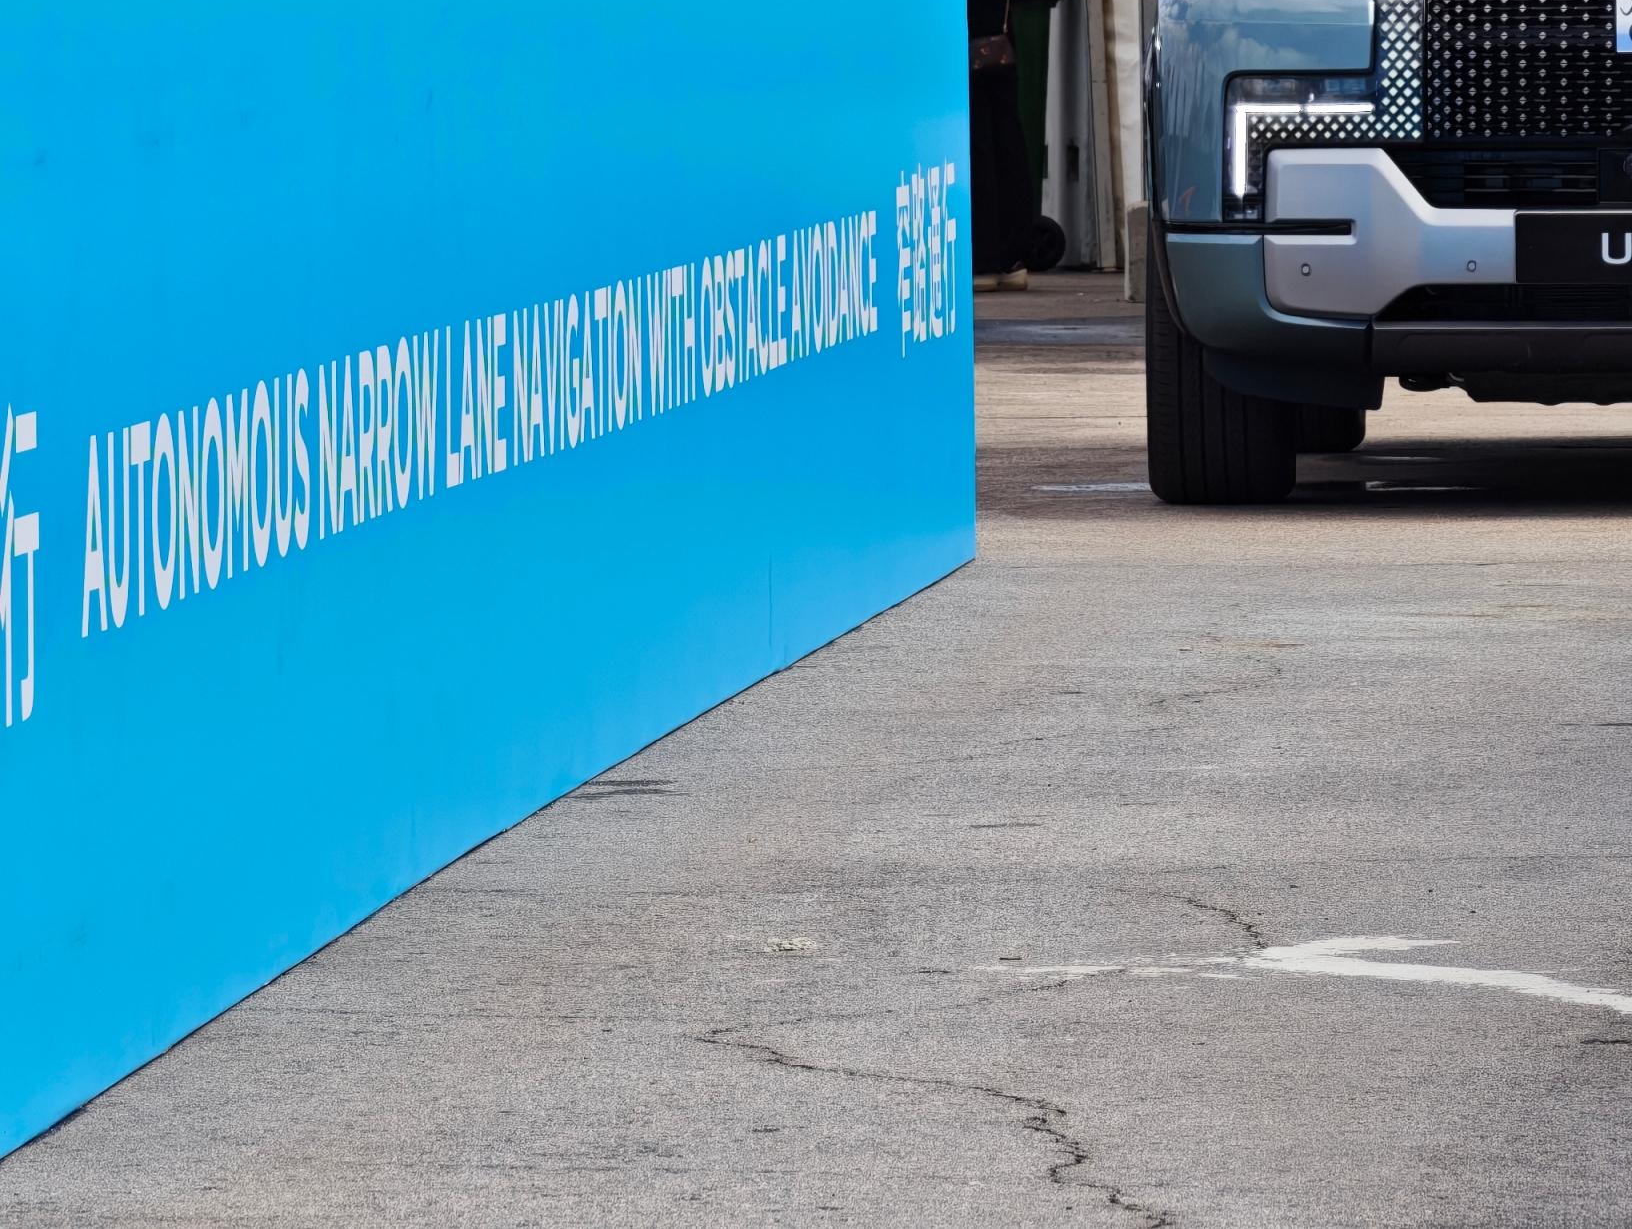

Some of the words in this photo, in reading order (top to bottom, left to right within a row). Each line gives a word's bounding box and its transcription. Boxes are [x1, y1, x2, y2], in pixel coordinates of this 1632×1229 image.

[82, 368, 311, 638] AUTONOMOUS
[319, 329, 439, 540] NARROW
[447, 304, 507, 488] LANE
[514, 277, 642, 466] NAVIGATION
[647, 263, 696, 416] WITH
[700, 234, 787, 397] OBSTACLE
[792, 210, 878, 361] AVOIDANCE
[895, 156, 957, 359] 窄路通行
